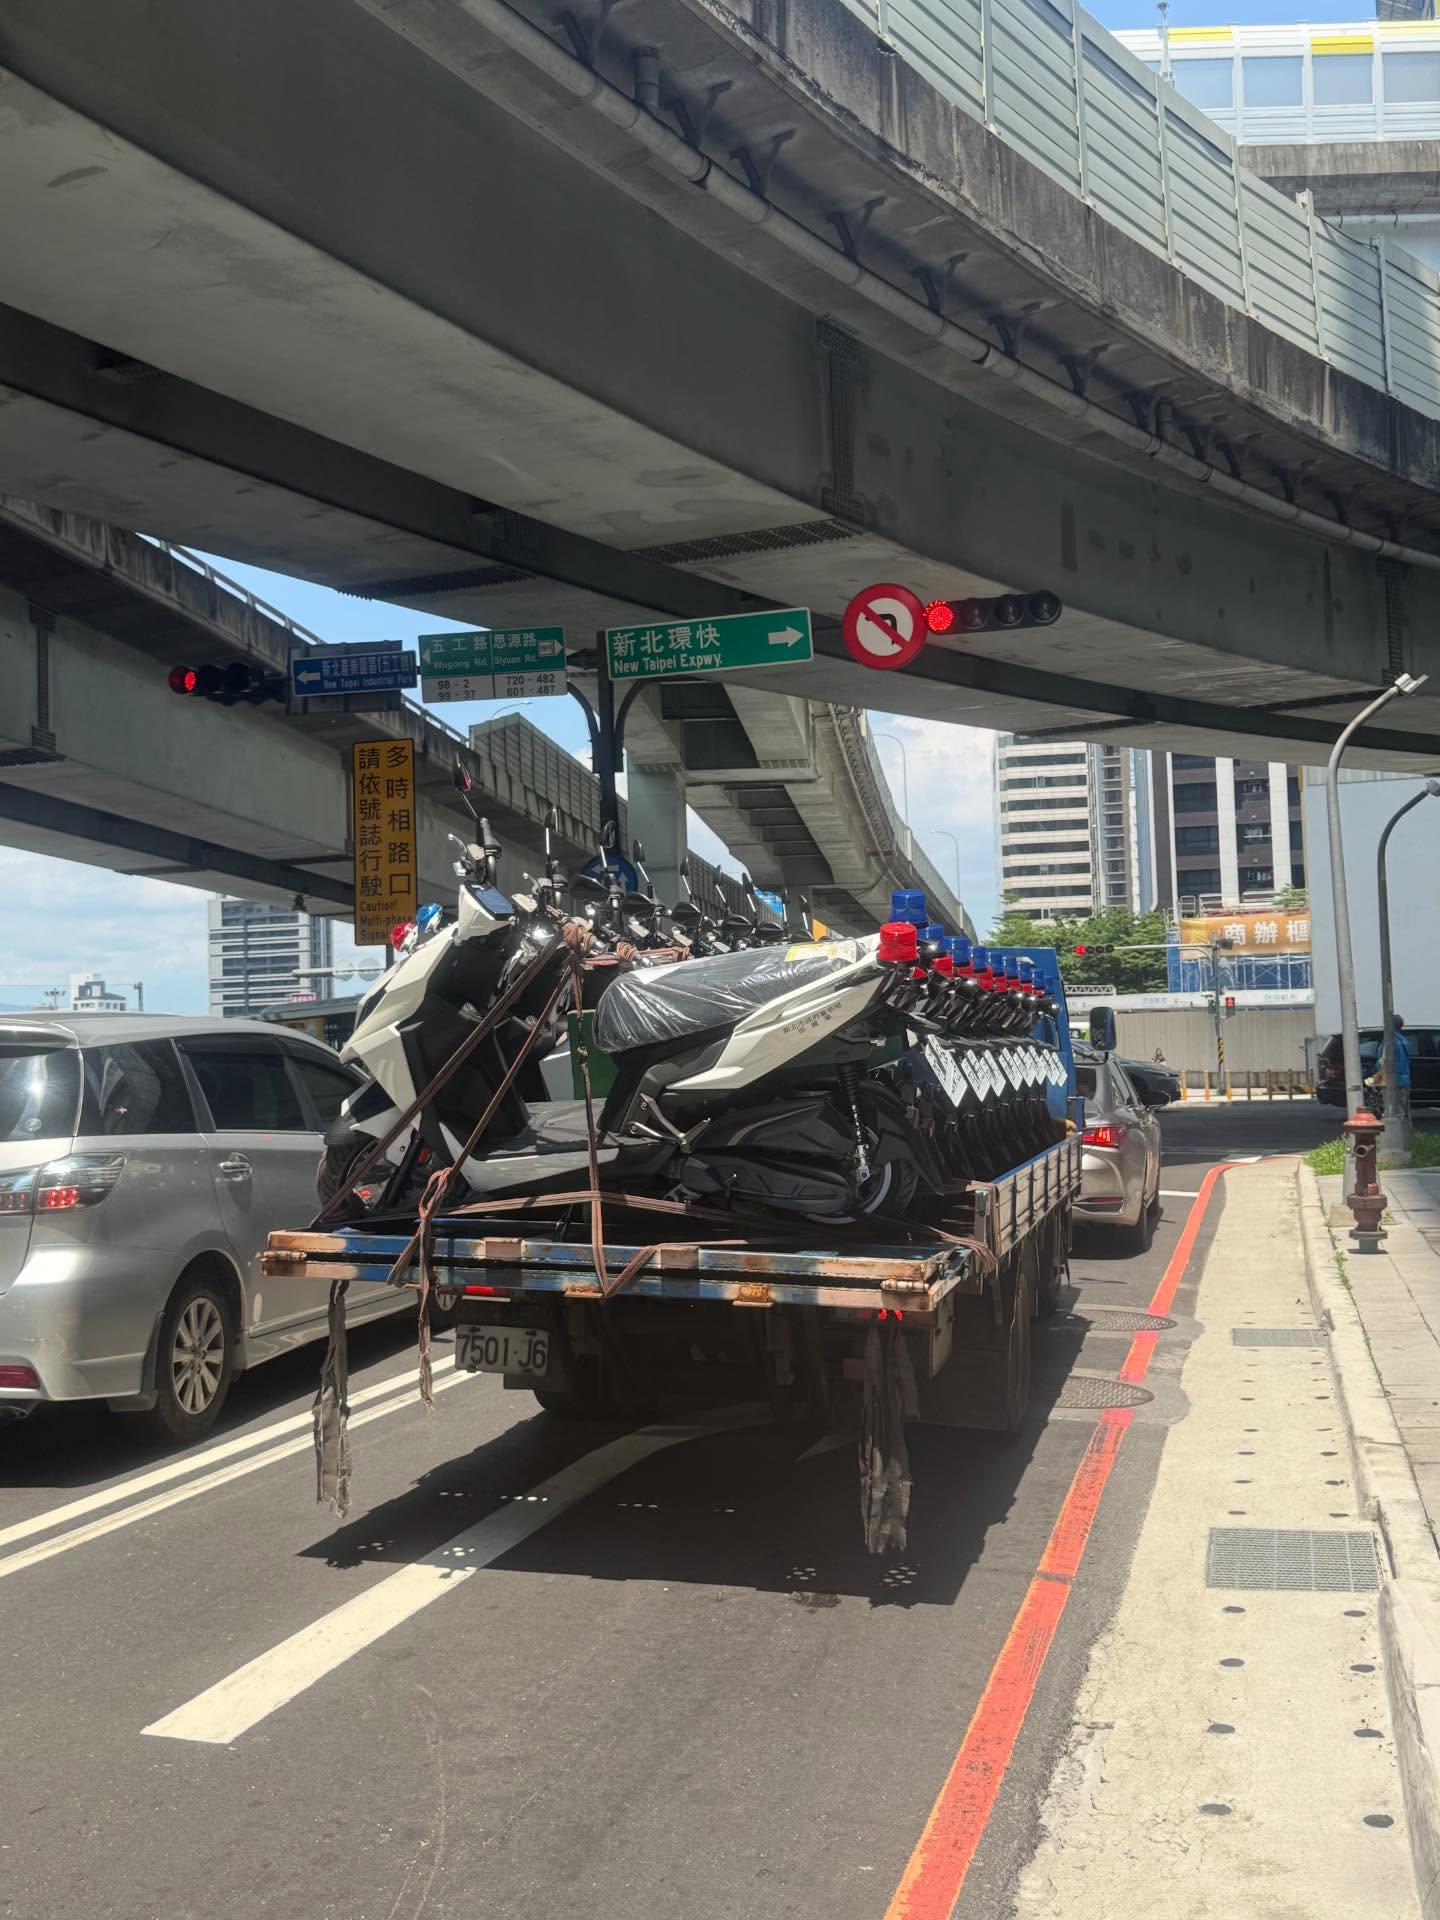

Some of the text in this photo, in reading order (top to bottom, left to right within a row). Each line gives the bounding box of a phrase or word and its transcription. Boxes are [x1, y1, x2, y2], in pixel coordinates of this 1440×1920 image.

[431, 635, 488, 653] 五工路
[493, 632, 537, 649] 思源路
[612, 623, 721, 657] 新北環快
[433, 657, 488, 671] Wugong Rd.
[494, 654, 538, 666] Siyuan Rd.
[614, 653, 723, 674] New Taipei Expwy.
[438, 681, 451, 690] 98
[463, 679, 470, 688] 2
[506, 676, 525, 686] 720
[536, 673, 555, 684] 482
[438, 691, 451, 701] 99
[464, 690, 476, 700] 37
[537, 685, 556, 695] 487
[358, 748, 383, 897] 請依號誌行駛
[386, 745, 412, 897] 多時相路口
[1223, 919, 1309, 945] 商辦樞
